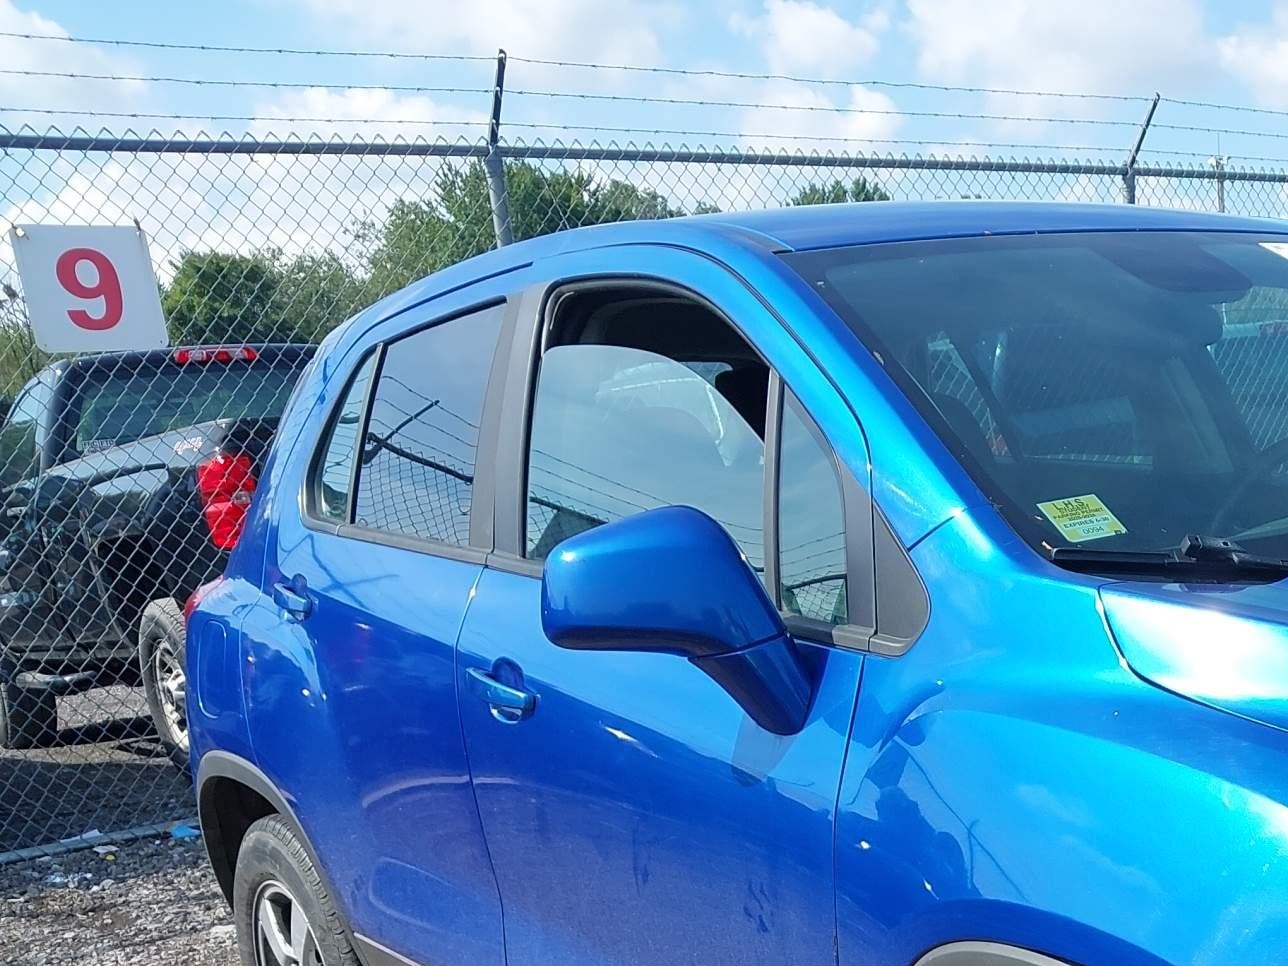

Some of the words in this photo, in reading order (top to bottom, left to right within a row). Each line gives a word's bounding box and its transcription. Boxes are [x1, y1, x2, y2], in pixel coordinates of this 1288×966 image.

[55, 247, 124, 331] 9
[1053, 511, 1081, 519] PARKING
[1063, 520, 1095, 529] EXPIRES
